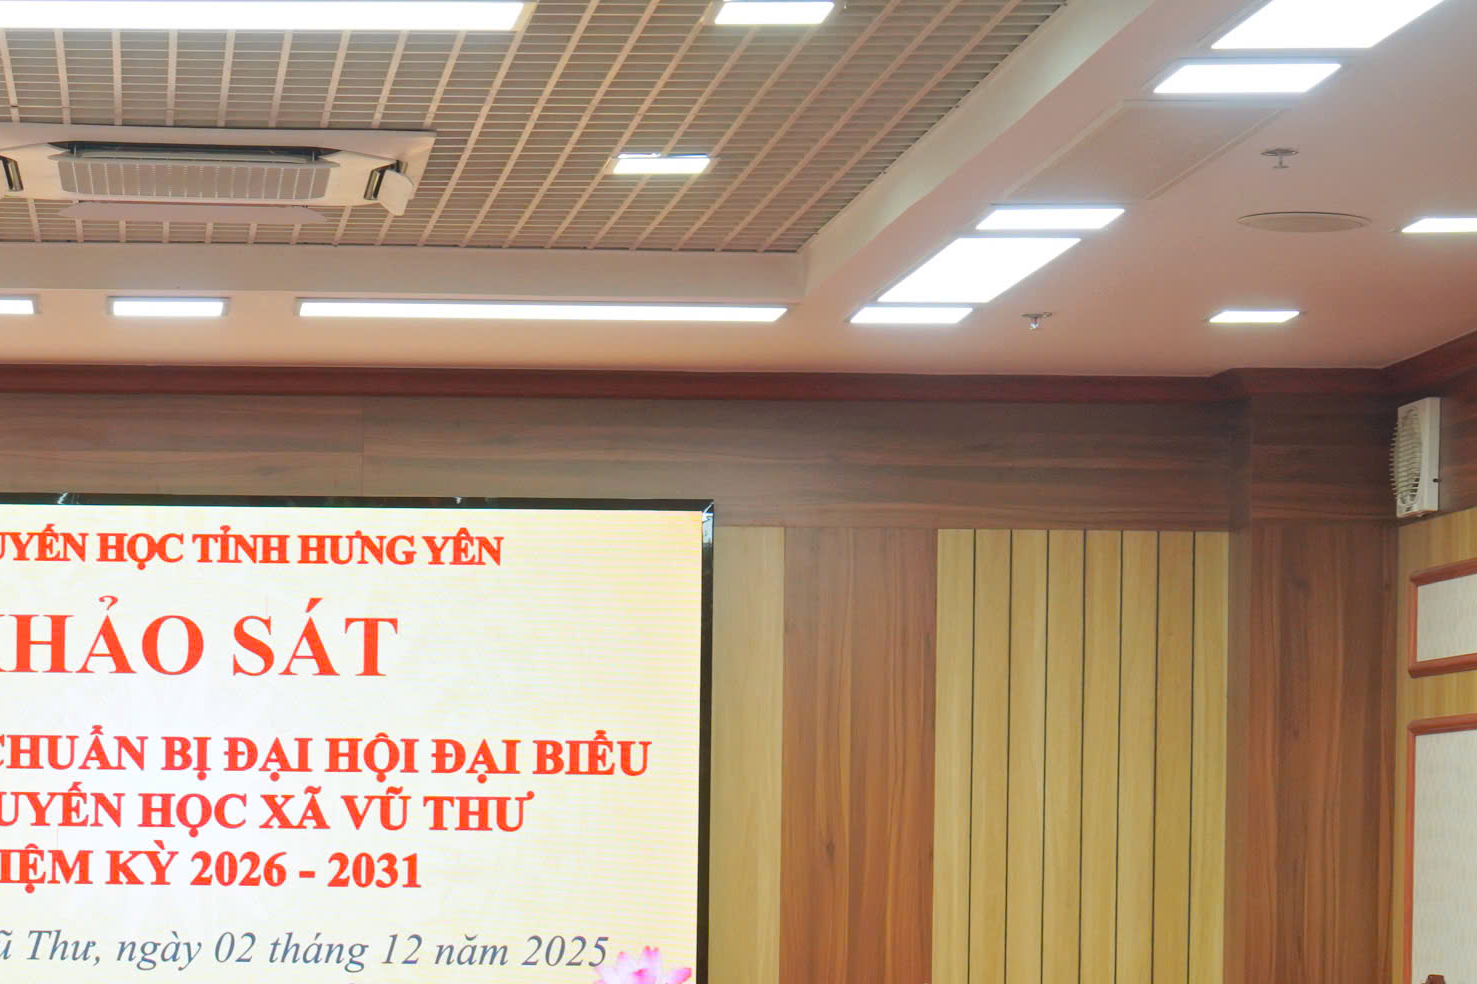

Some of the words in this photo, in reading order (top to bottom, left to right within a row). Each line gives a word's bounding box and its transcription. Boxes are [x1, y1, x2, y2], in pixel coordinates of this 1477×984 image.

[96, 532, 184, 570] HỌC
[192, 525, 290, 564] TỈNH
[297, 530, 417, 566] HƯNG
[422, 527, 504, 567] YÊN
[232, 597, 399, 677] SÁT
[161, 736, 212, 781] BỊ
[223, 737, 313, 782] ĐẠI
[324, 732, 419, 783] HỘI
[430, 738, 521, 784] ĐẠI
[532, 729, 652, 777] BIỂU
[137, 793, 247, 838] HỌC
[259, 785, 331, 829] XÃ
[340, 786, 412, 831] VŨ
[422, 790, 535, 833] THƯ
[104, 839, 179, 885] KỲ
[190, 851, 287, 887] 2026
[298, 870, 316, 879] -
[327, 852, 422, 888] 2031
[26, 929, 101, 967] Thư,
[116, 931, 203, 972] ngày
[214, 931, 257, 964] 02
[268, 932, 369, 973] tháng
[381, 933, 423, 965] 12
[434, 933, 509, 967] năm
[521, 935, 609, 968] 2025
